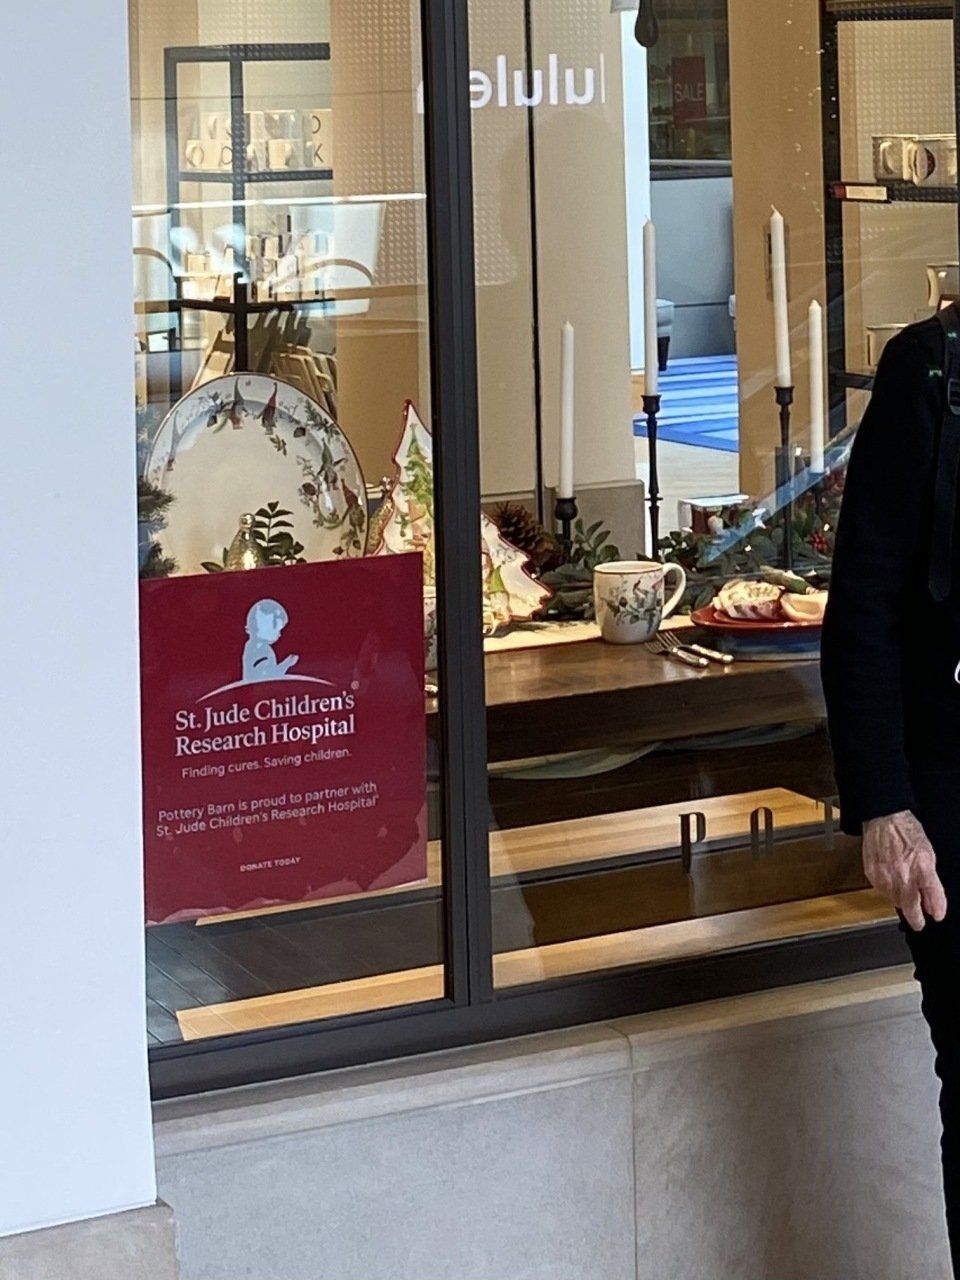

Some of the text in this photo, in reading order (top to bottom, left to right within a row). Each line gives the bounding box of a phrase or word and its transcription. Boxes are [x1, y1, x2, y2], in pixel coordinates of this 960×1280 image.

[674, 82, 705, 103] SALE
[175, 691, 355, 732] St. Jude Children's
[175, 714, 355, 756] Research Hospital
[182, 748, 352, 779] Finding cures. Saving children.
[156, 796, 378, 837] St. Jude Children's Research Hospital
[158, 781, 377, 822] Pottery Barn is proud to partner with
[240, 856, 301, 872] DONATE TODAY
